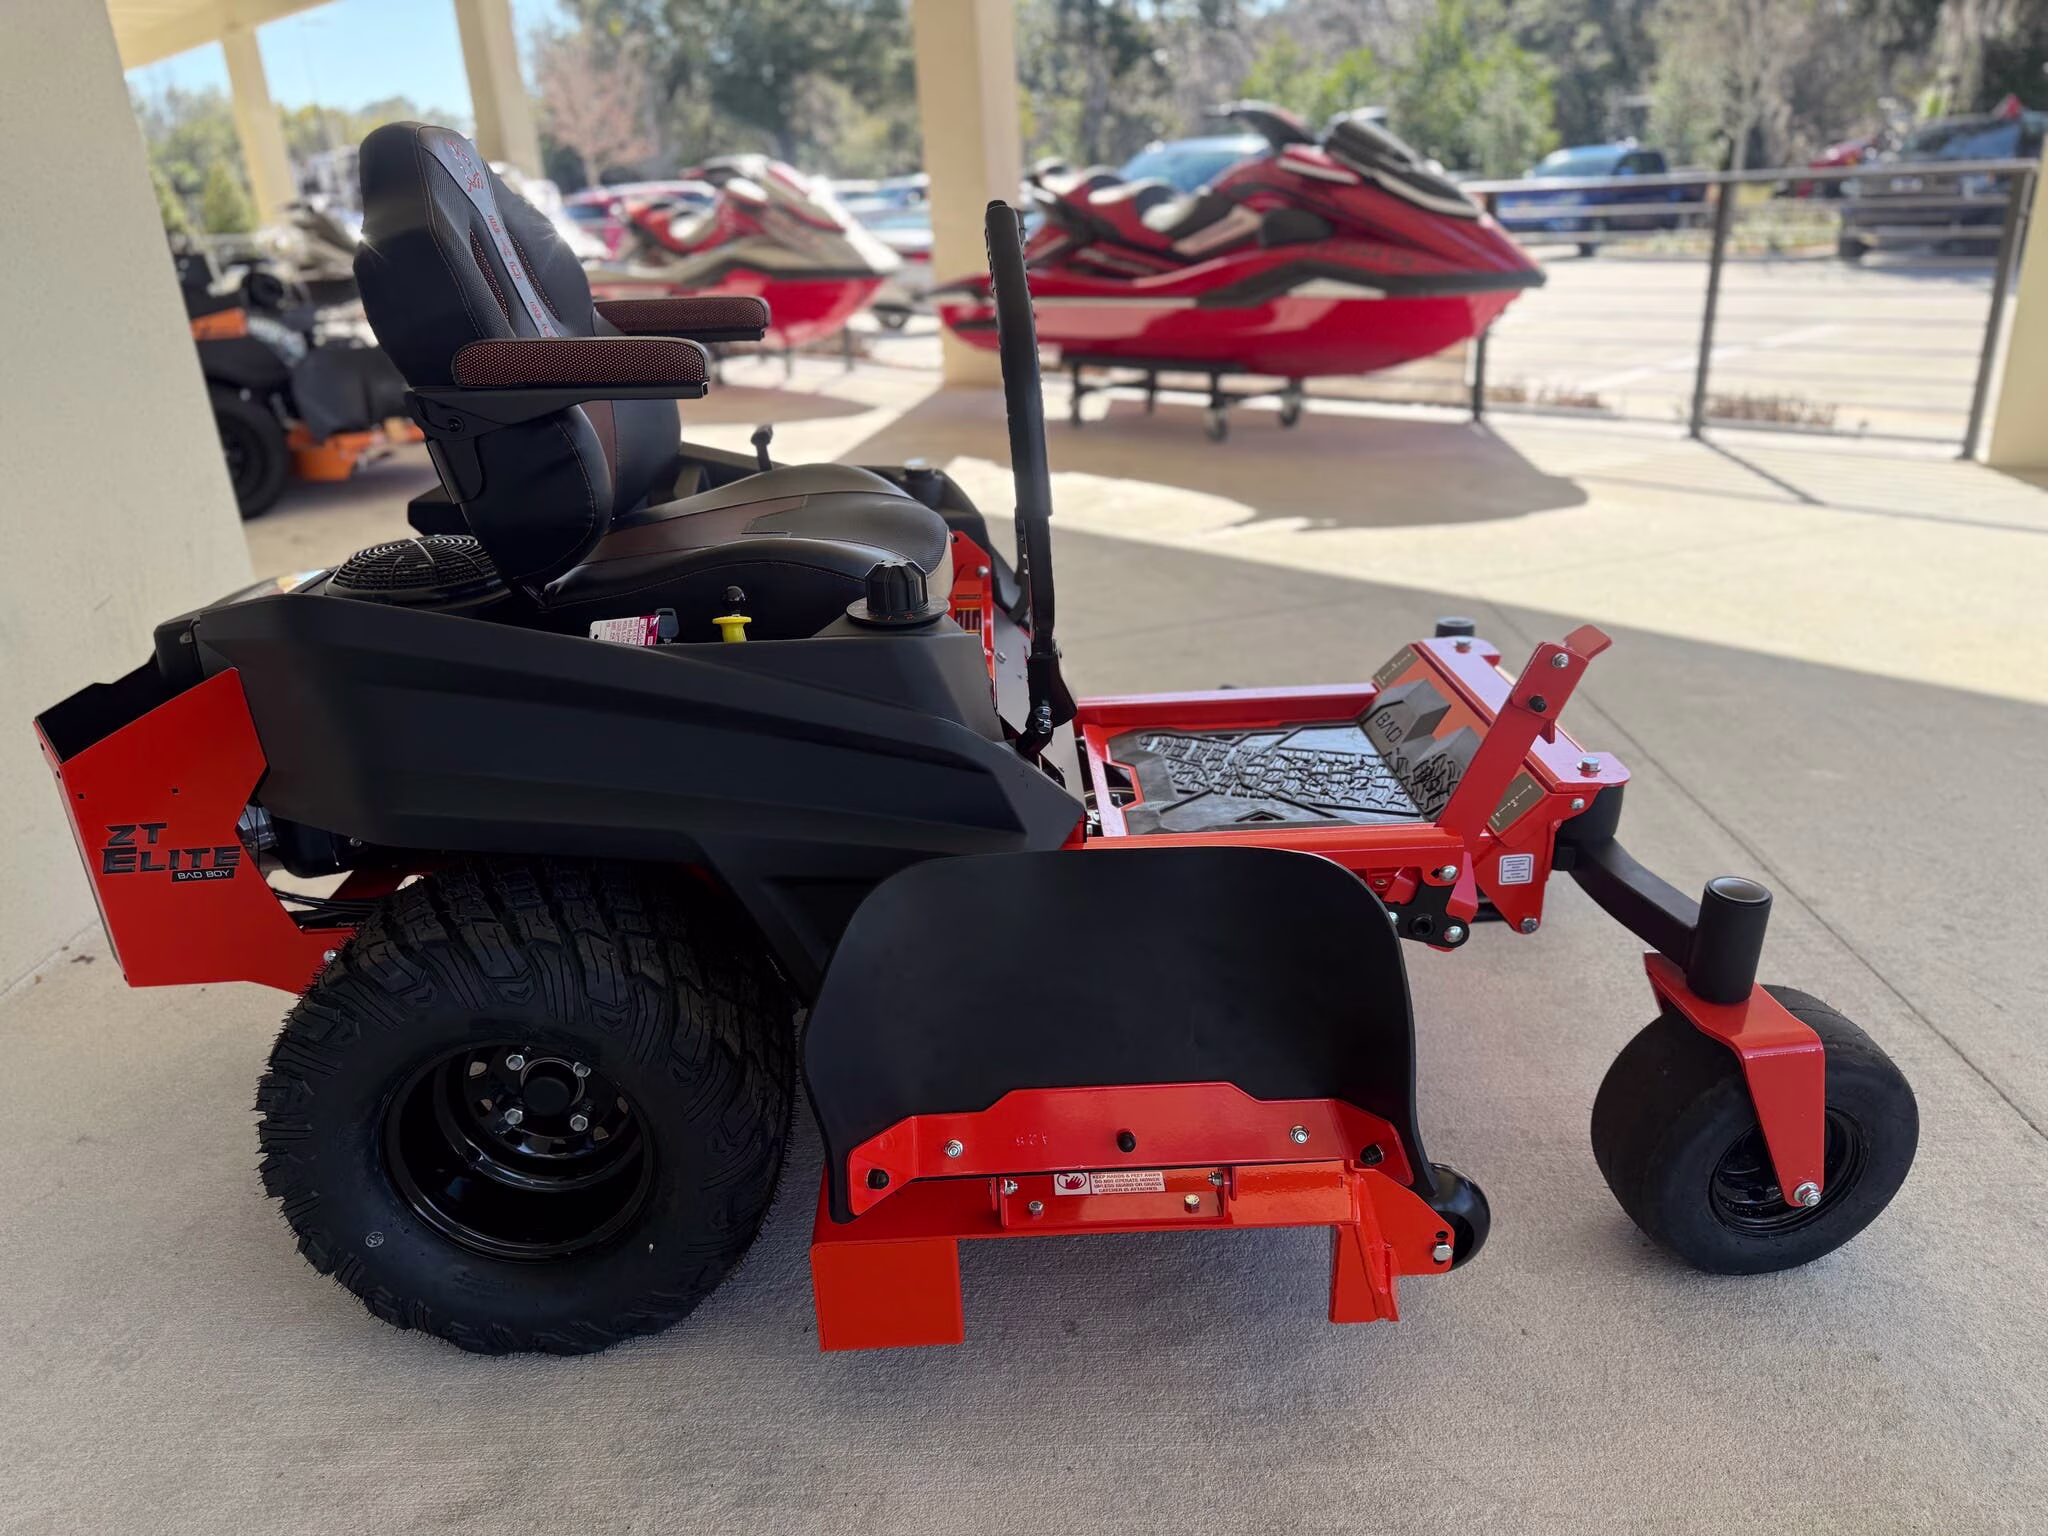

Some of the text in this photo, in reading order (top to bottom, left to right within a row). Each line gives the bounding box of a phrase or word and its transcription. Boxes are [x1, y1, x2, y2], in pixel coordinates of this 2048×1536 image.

[1376, 711, 1402, 743] BAD
[106, 822, 168, 846] ZT
[101, 845, 241, 874] ELITE
[177, 869, 231, 880] BAD BOY
